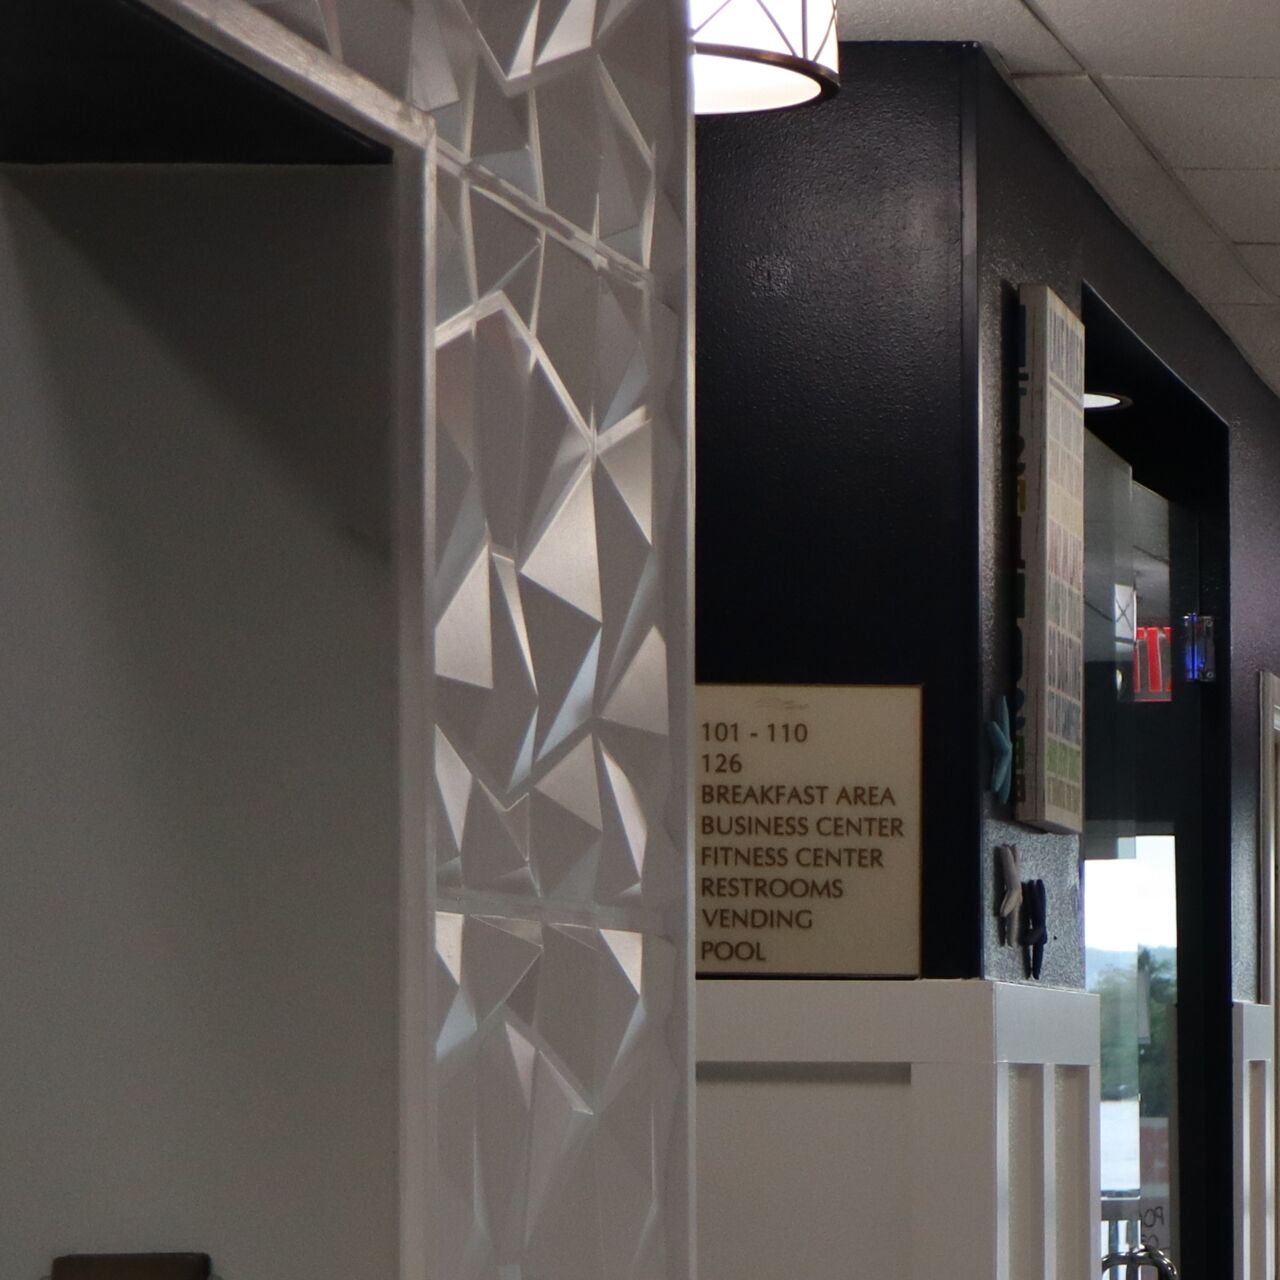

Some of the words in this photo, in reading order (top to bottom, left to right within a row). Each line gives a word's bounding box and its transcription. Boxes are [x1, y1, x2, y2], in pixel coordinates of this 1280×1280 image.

[701, 722, 740, 743] 101
[766, 722, 809, 744] 110
[701, 753, 743, 774] 126
[701, 784, 829, 806] BREAKFAST
[835, 785, 897, 807] AREA
[701, 815, 809, 837] BUSINESS
[816, 816, 904, 838] CENTER
[701, 847, 789, 868] FITNESS
[795, 848, 884, 869] CENTER
[701, 877, 844, 900] RESTROOMS
[701, 908, 813, 930] VENDING
[701, 940, 767, 962] POOL
